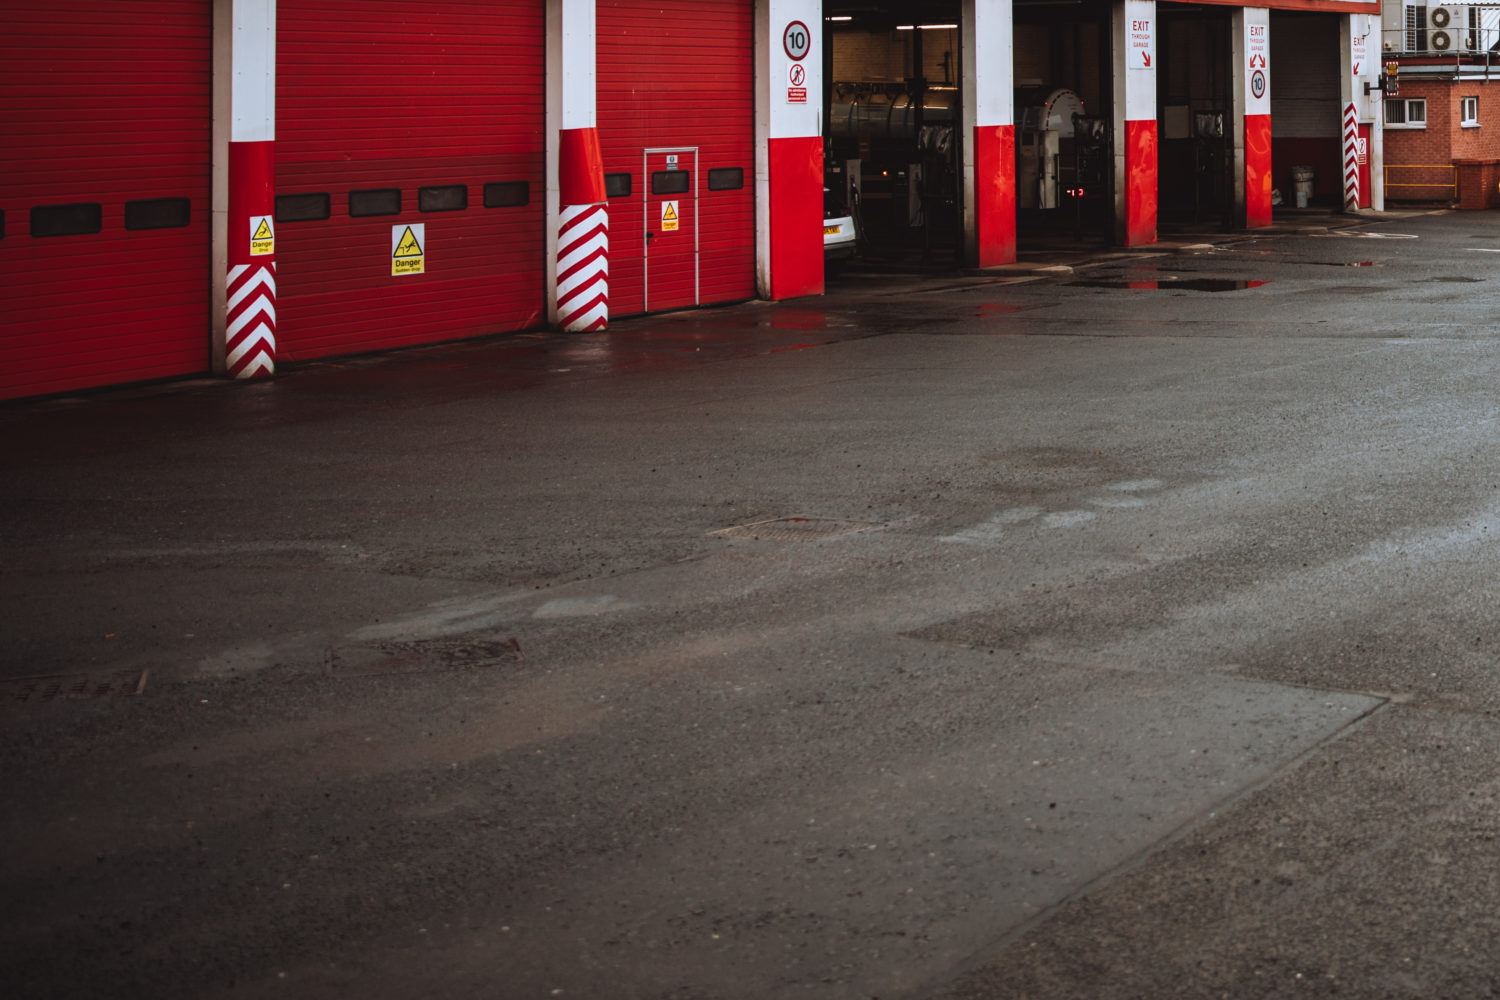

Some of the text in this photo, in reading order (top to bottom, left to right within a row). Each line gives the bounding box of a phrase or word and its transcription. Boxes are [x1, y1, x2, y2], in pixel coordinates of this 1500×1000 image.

[1132, 20, 1149, 31] EXIT
[1250, 26, 1264, 36] EXIT
[788, 31, 805, 49] 10
[1254, 77, 1263, 90] 10
[395, 259, 421, 268] Danger
